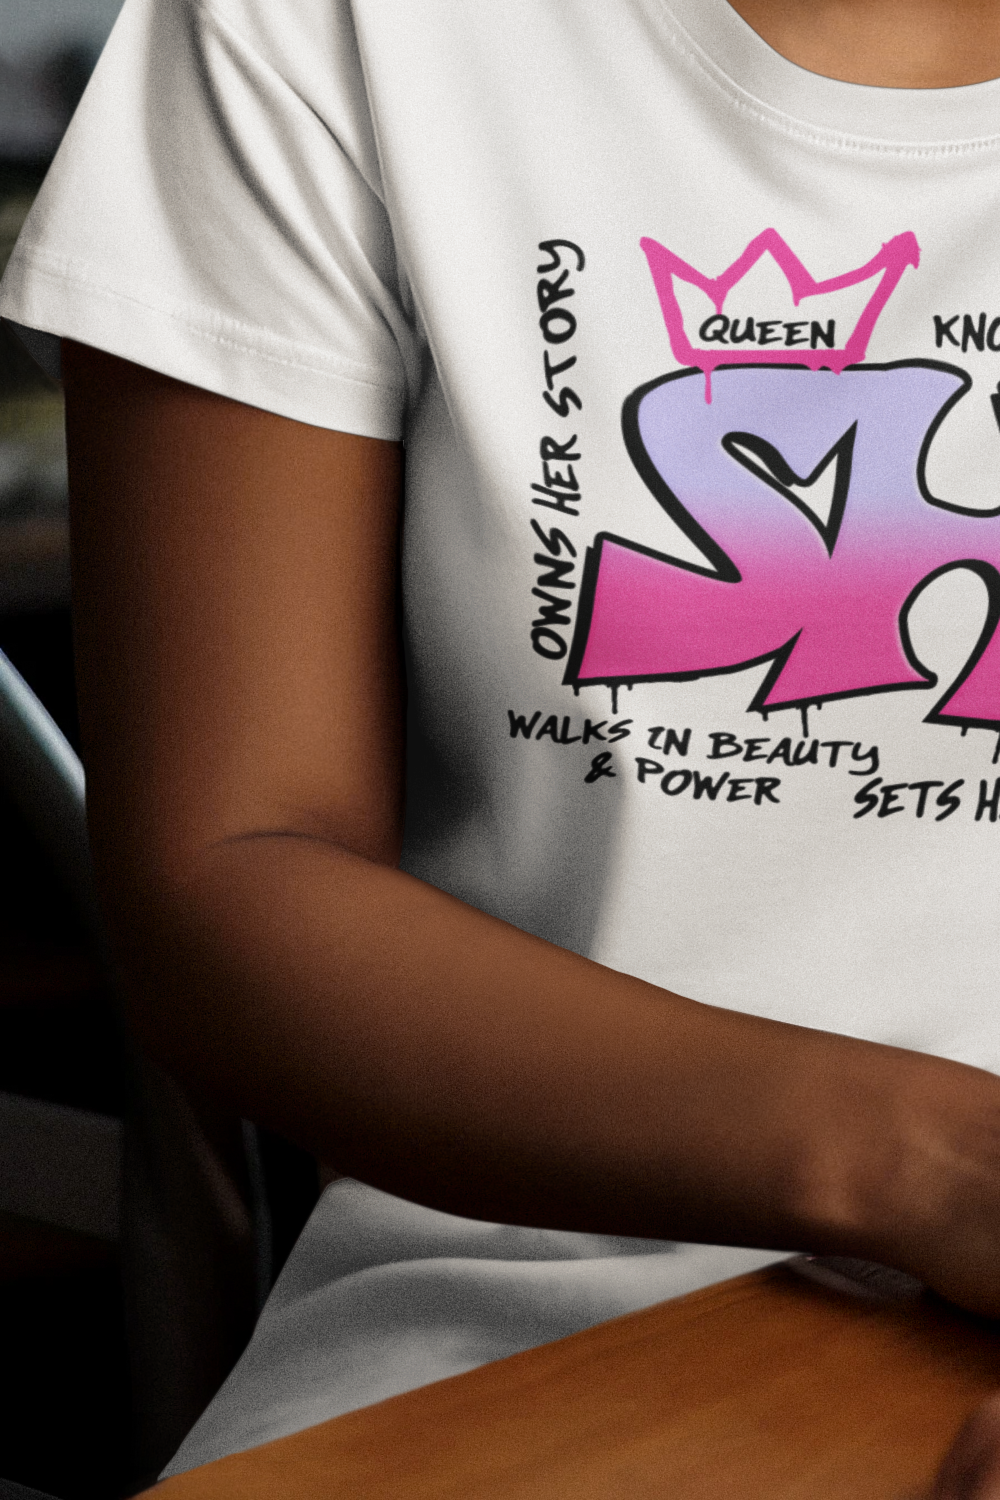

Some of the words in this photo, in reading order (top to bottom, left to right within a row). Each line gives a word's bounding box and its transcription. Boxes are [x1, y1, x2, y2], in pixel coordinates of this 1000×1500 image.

[537, 239, 585, 418] STORY
[699, 313, 835, 349] QUEEN
[531, 434, 581, 516] HER
[530, 519, 577, 661] OWNS
[506, 708, 633, 746] WALKS
[648, 726, 692, 757] IN
[706, 732, 880, 776] BEAUTY
[583, 751, 617, 784] &
[635, 756, 781, 806] POWER
[853, 777, 965, 822] SETS
